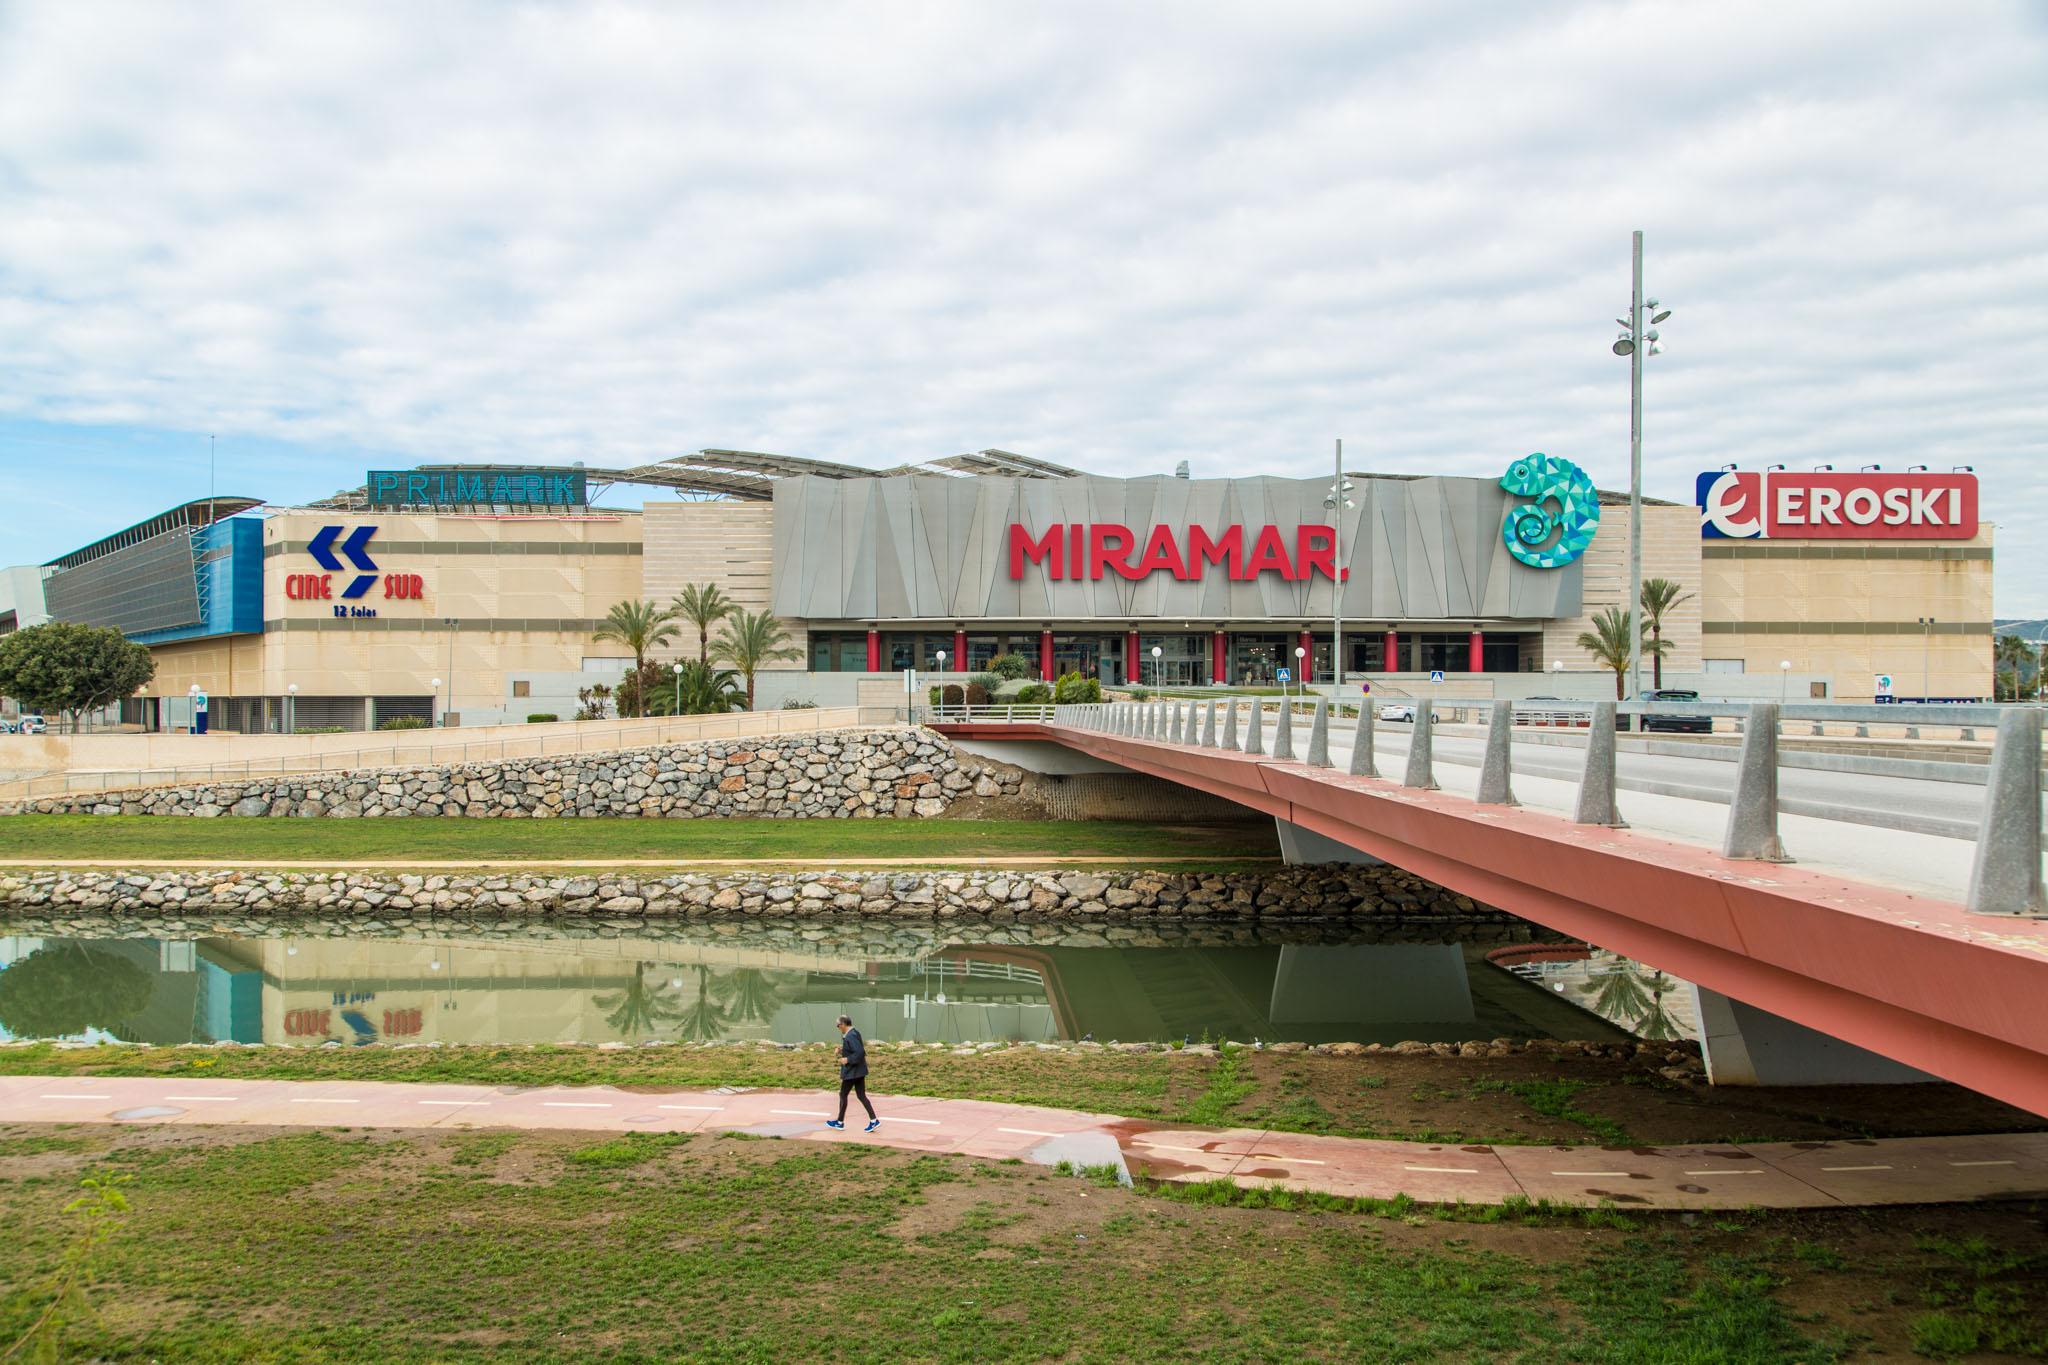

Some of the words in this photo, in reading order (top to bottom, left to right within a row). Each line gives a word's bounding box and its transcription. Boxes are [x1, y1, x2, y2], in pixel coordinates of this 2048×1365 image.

[376, 473, 576, 502] PRIMARK
[1777, 488, 1962, 526] EROSKI
[1010, 523, 1350, 581] MIRAMAR
[285, 574, 333, 600] CINE
[384, 574, 424, 600] SUR
[334, 605, 347, 618] 12
[351, 605, 377, 618] Salas
